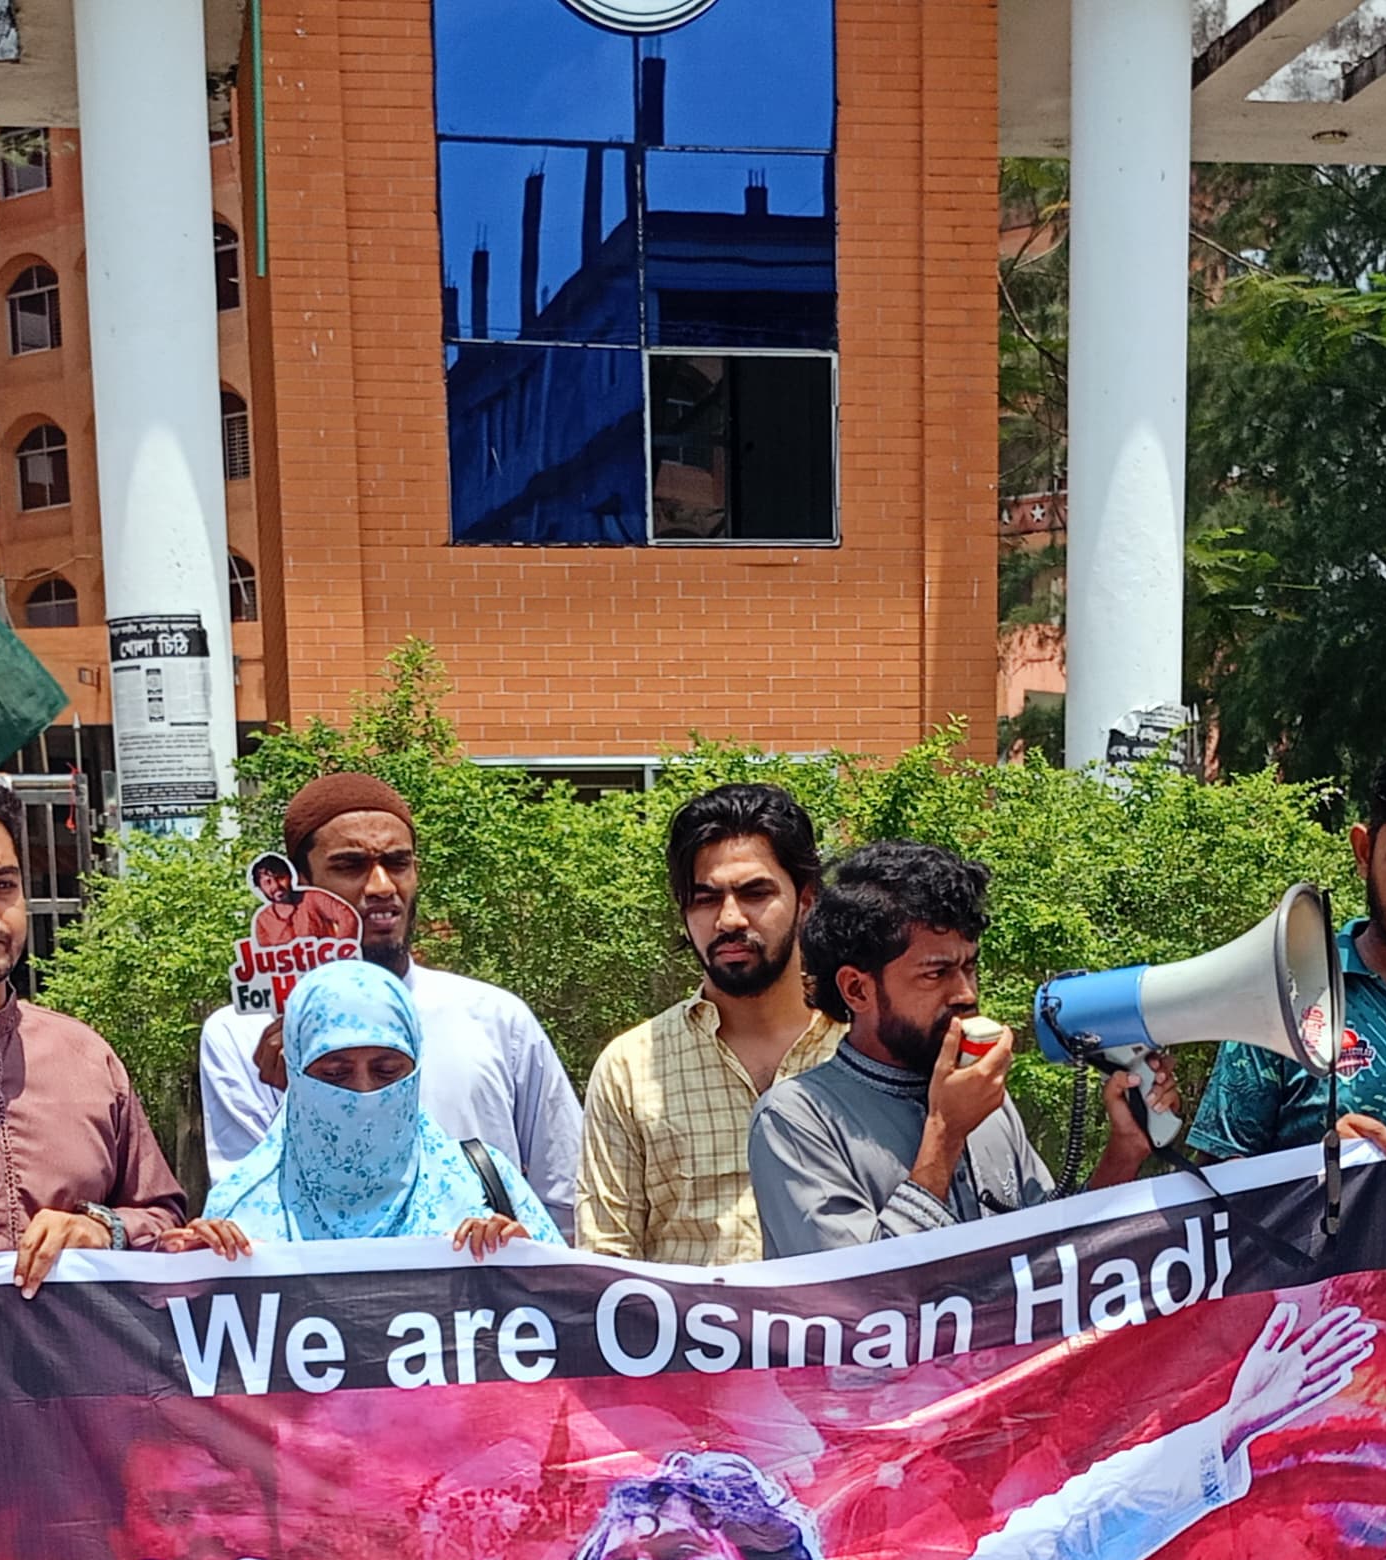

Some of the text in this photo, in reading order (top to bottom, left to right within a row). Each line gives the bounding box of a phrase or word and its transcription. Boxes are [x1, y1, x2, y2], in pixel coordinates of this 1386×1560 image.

[157, 632, 189, 655] চিঠি
[235, 940, 358, 982] Justice
[237, 985, 271, 1011] For
[166, 1209, 1232, 1397] We are Osman Hadi
